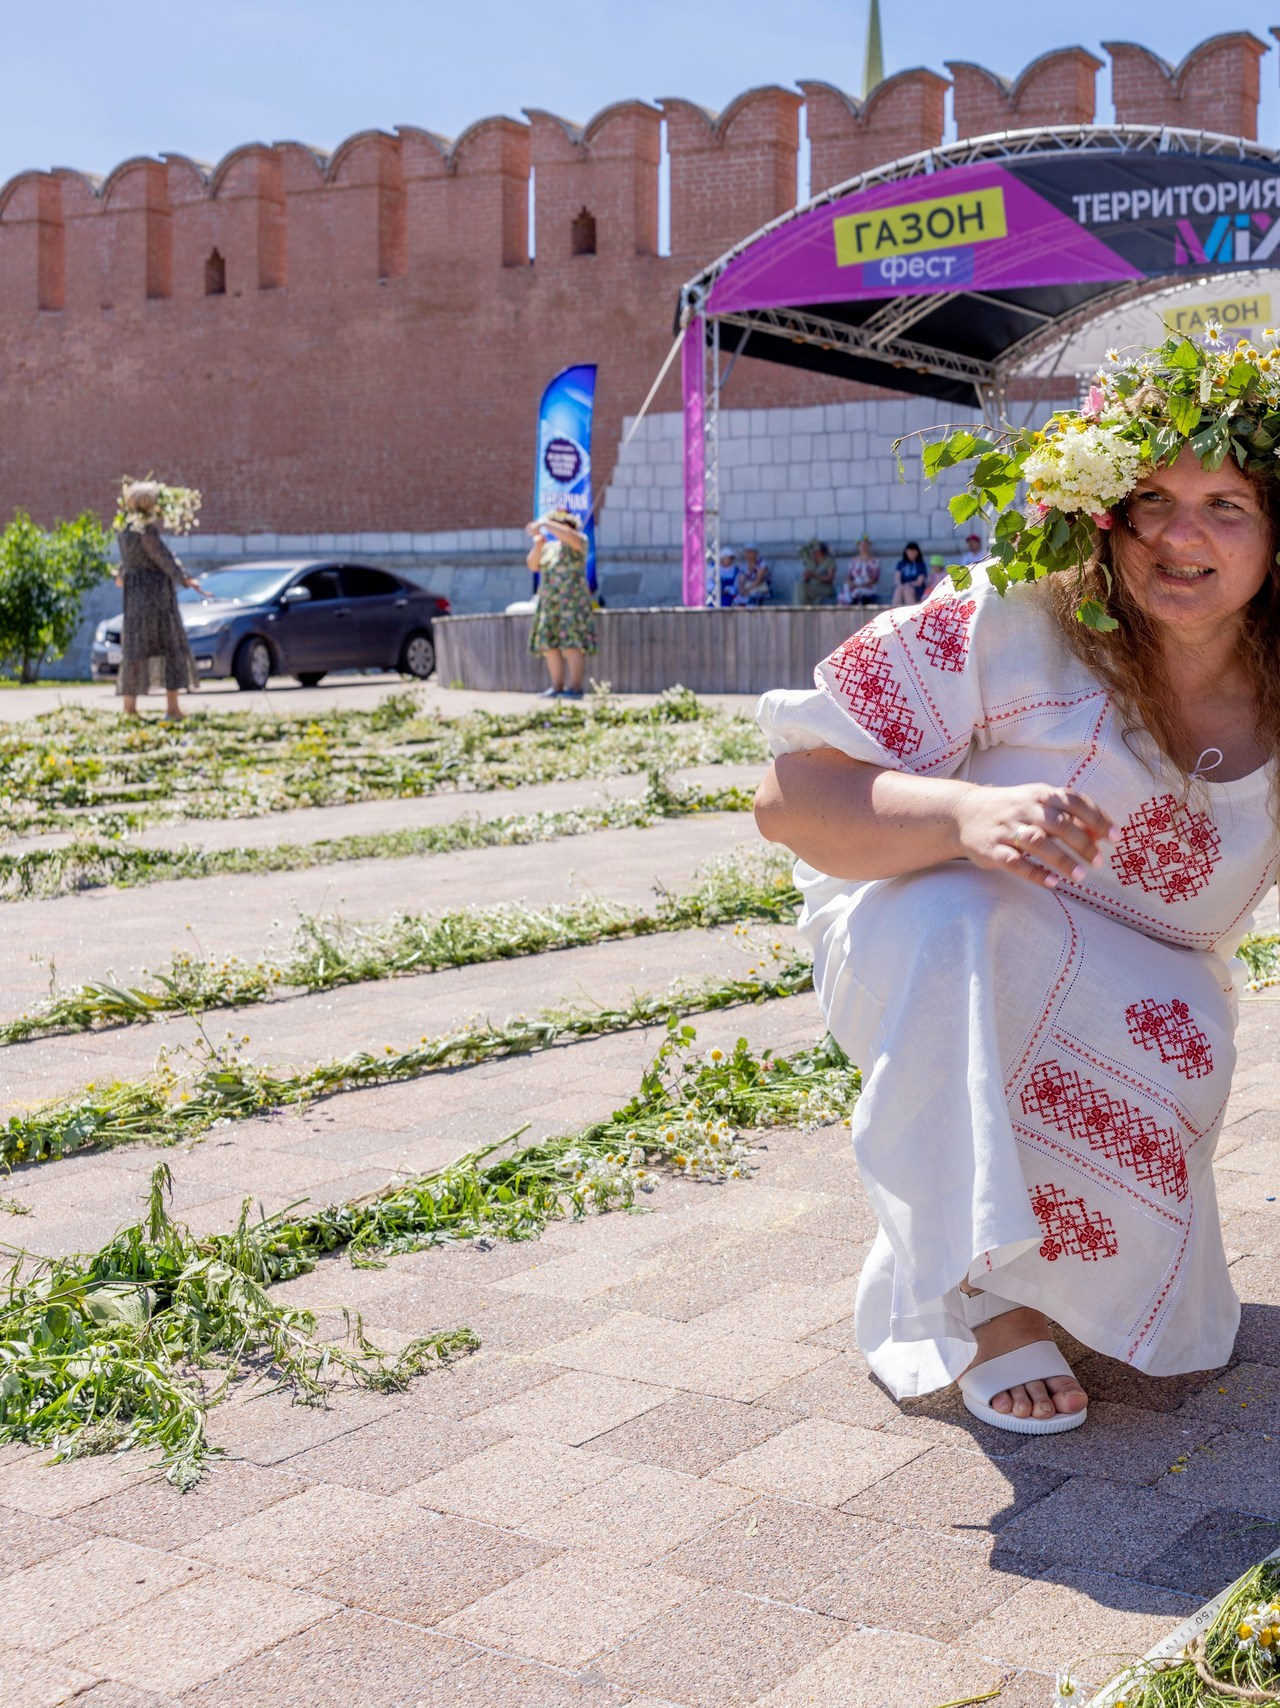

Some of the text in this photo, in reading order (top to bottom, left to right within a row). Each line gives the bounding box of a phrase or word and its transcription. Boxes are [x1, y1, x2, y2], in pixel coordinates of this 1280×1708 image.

[854, 201, 984, 253] ГАЗОН
[880, 256, 957, 286] фест
[1176, 300, 1259, 330] ГАЗОН
[1195, 1611, 1210, 1626] 50
